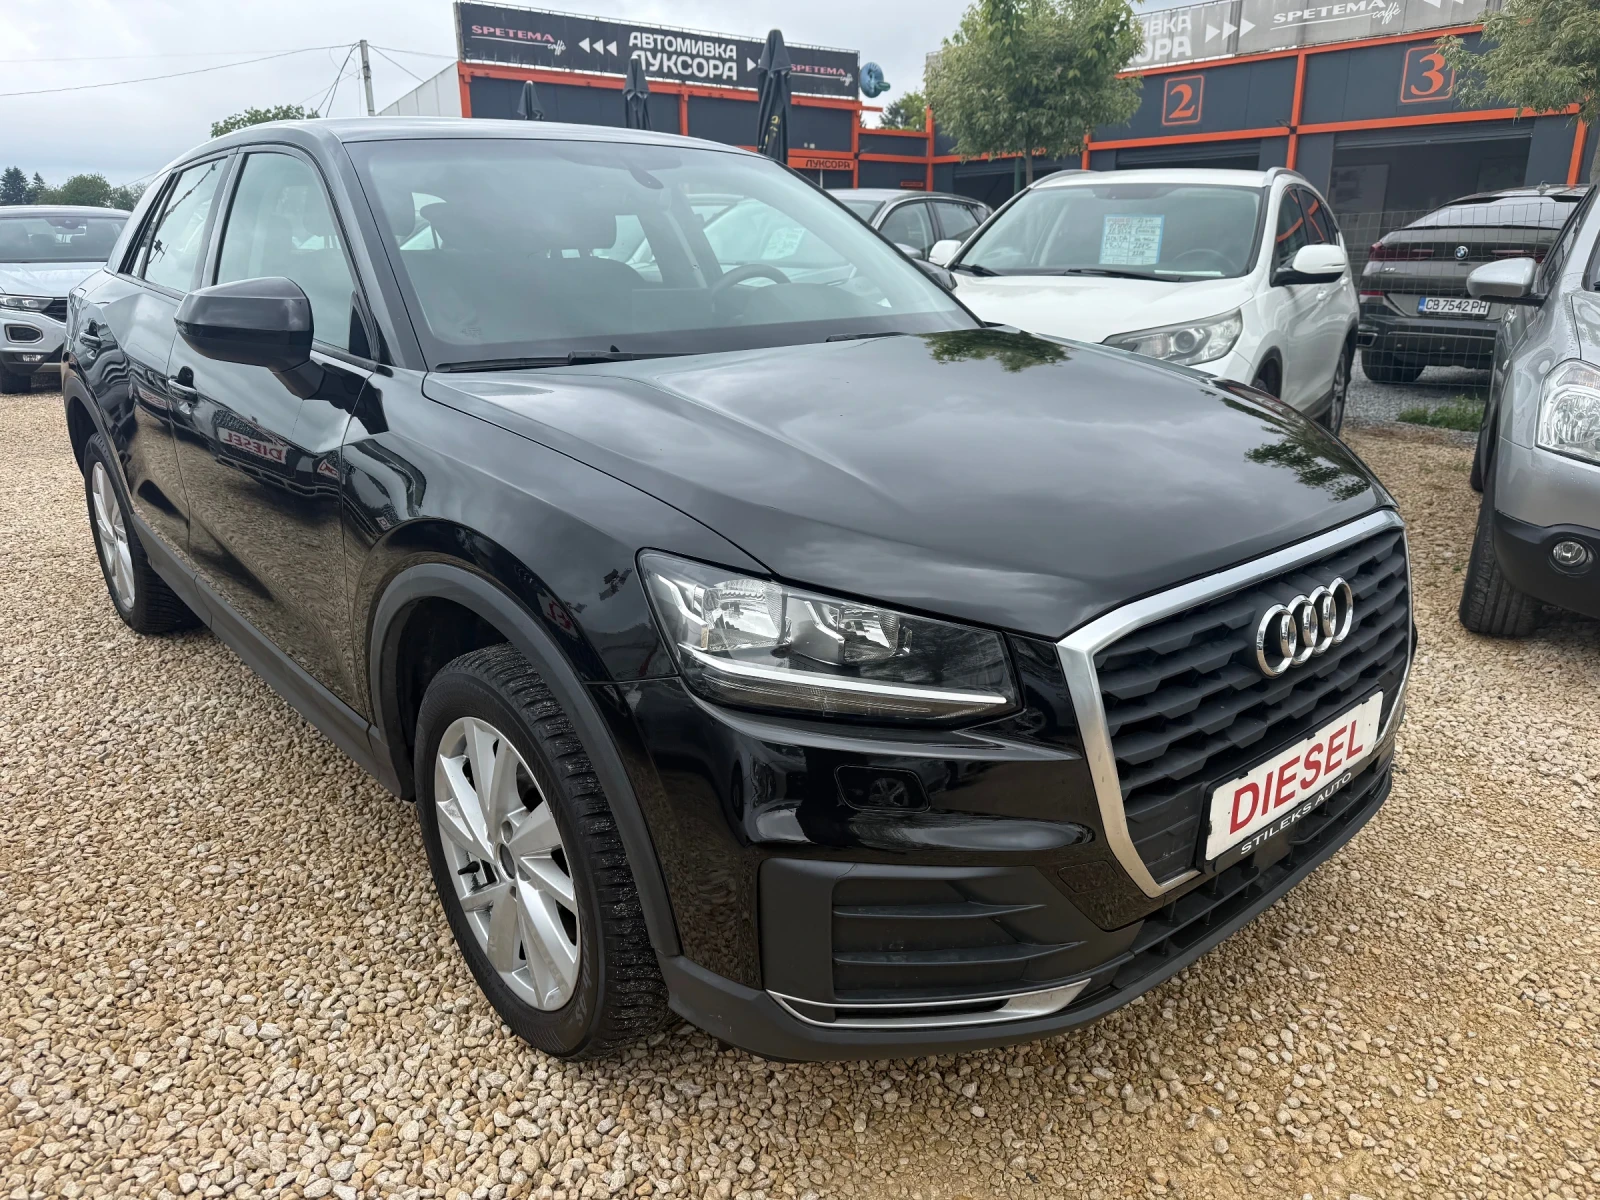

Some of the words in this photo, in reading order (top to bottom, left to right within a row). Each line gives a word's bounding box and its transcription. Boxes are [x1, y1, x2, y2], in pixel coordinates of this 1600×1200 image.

[1273, 0, 1387, 24] SPETEMA
[471, 25, 555, 42] SPETEMA
[628, 31, 737, 60] АВТОМИВКА
[791, 63, 846, 76] SPETEMA
[1410, 53, 1446, 96] 3
[1168, 83, 1195, 119] 2
[805, 159, 851, 169] ЛУКСОРА
[1441, 299, 1470, 312] 7542
[1229, 719, 1364, 835] DIESEL
[1240, 803, 1312, 855] STILEKS
[1314, 772, 1352, 807] AUTO
